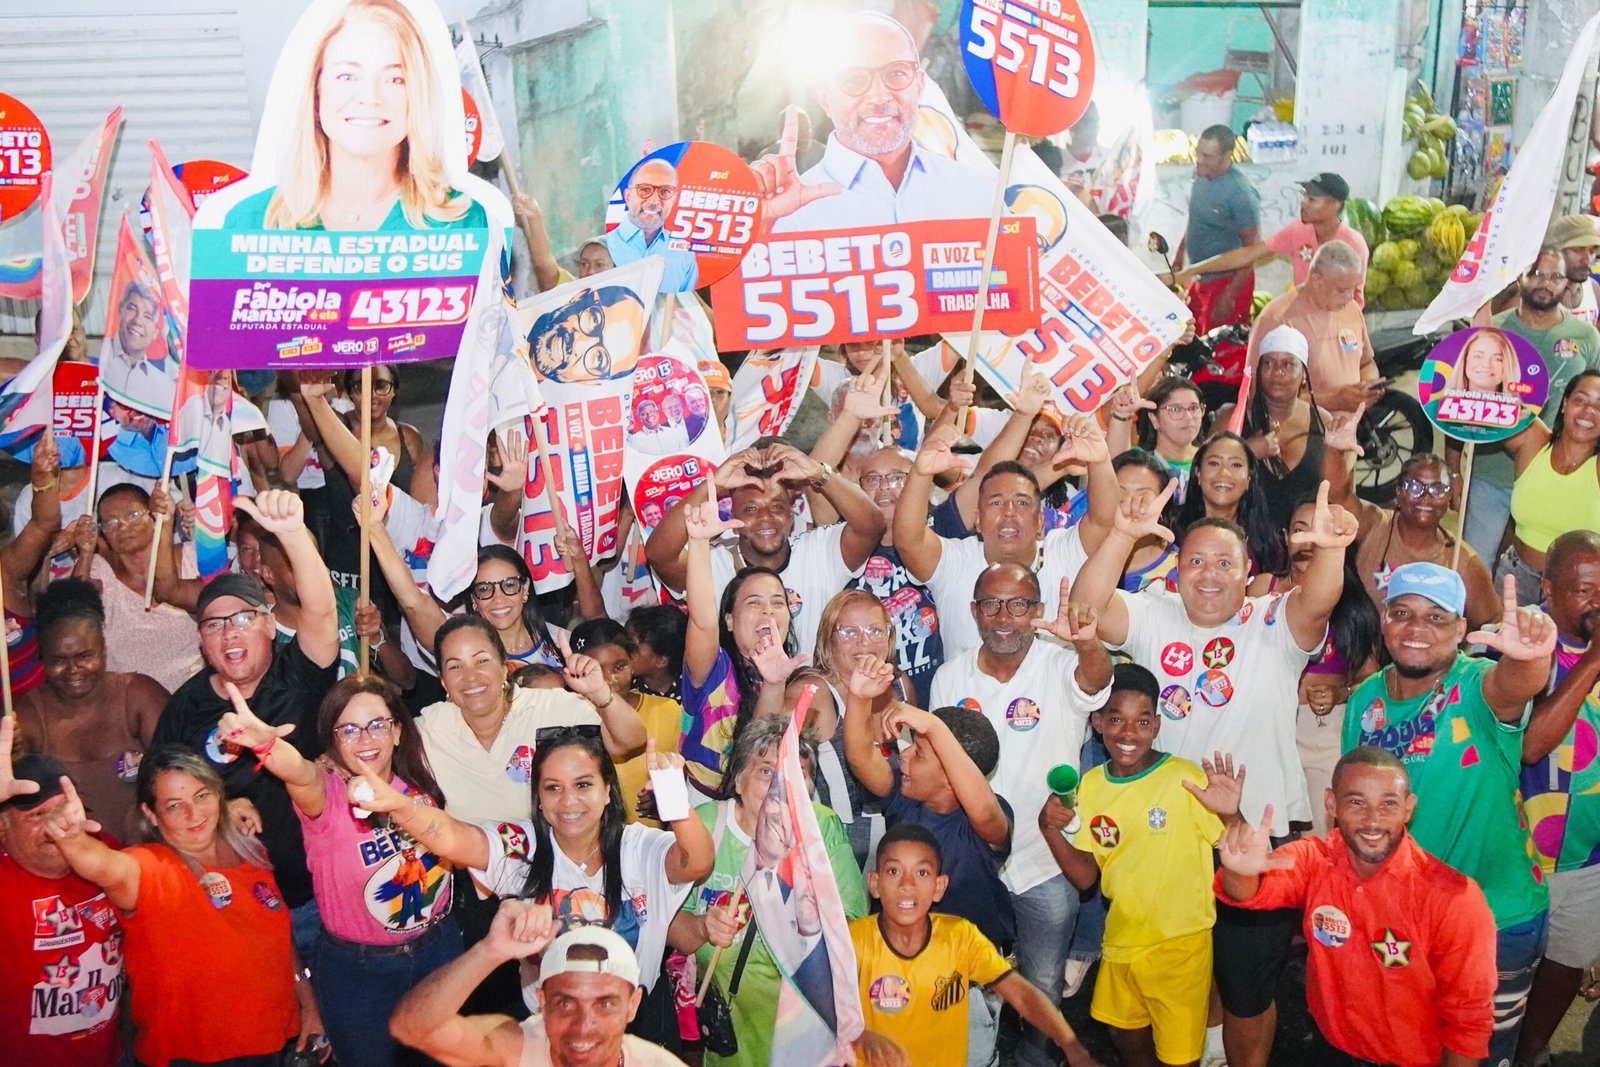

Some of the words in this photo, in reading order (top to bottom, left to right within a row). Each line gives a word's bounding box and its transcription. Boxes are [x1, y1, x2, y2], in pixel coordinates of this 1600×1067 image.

[967, 6, 1082, 98] 5513
[710, 171, 729, 180] psd
[678, 189, 759, 215] BEBETO
[669, 209, 754, 244] 5513
[231, 234, 333, 253] MINHA
[338, 233, 480, 254] ESTADUAL
[246, 255, 381, 273] DEFENDE
[386, 255, 409, 273] O
[412, 254, 463, 272] SUS
[741, 231, 912, 279] BEBETO
[930, 247, 940, 264] A
[944, 246, 970, 263] VOZ
[233, 286, 342, 310] Fabíola
[350, 286, 470, 325] 43123
[744, 270, 919, 342] 5513
[231, 308, 308, 323] Mansur
[318, 311, 338, 321] ela
[1047, 253, 1163, 364] BEBETO
[365, 342, 377, 352] 13
[388, 338, 414, 349] LULA
[634, 367, 656, 383] ERO
[658, 362, 671, 377] 13
[54, 408, 97, 430] 55
[1438, 398, 1517, 426] 43123
[569, 419, 584, 439] VOZ
[572, 453, 589, 494] BAHIA
[586, 396, 624, 554] BEBETO
[653, 465, 683, 482] JERO
[685, 462, 698, 475] 13
[1213, 648, 1223, 659] 13
[509, 832, 522, 847] 13
[1101, 827, 1112, 838] 13
[208, 885, 229, 895] 5513
[58, 910, 69, 923] 13
[1323, 922, 1347, 935] 5513
[1385, 942, 1399, 955] 13
[56, 965, 69, 979] 13
